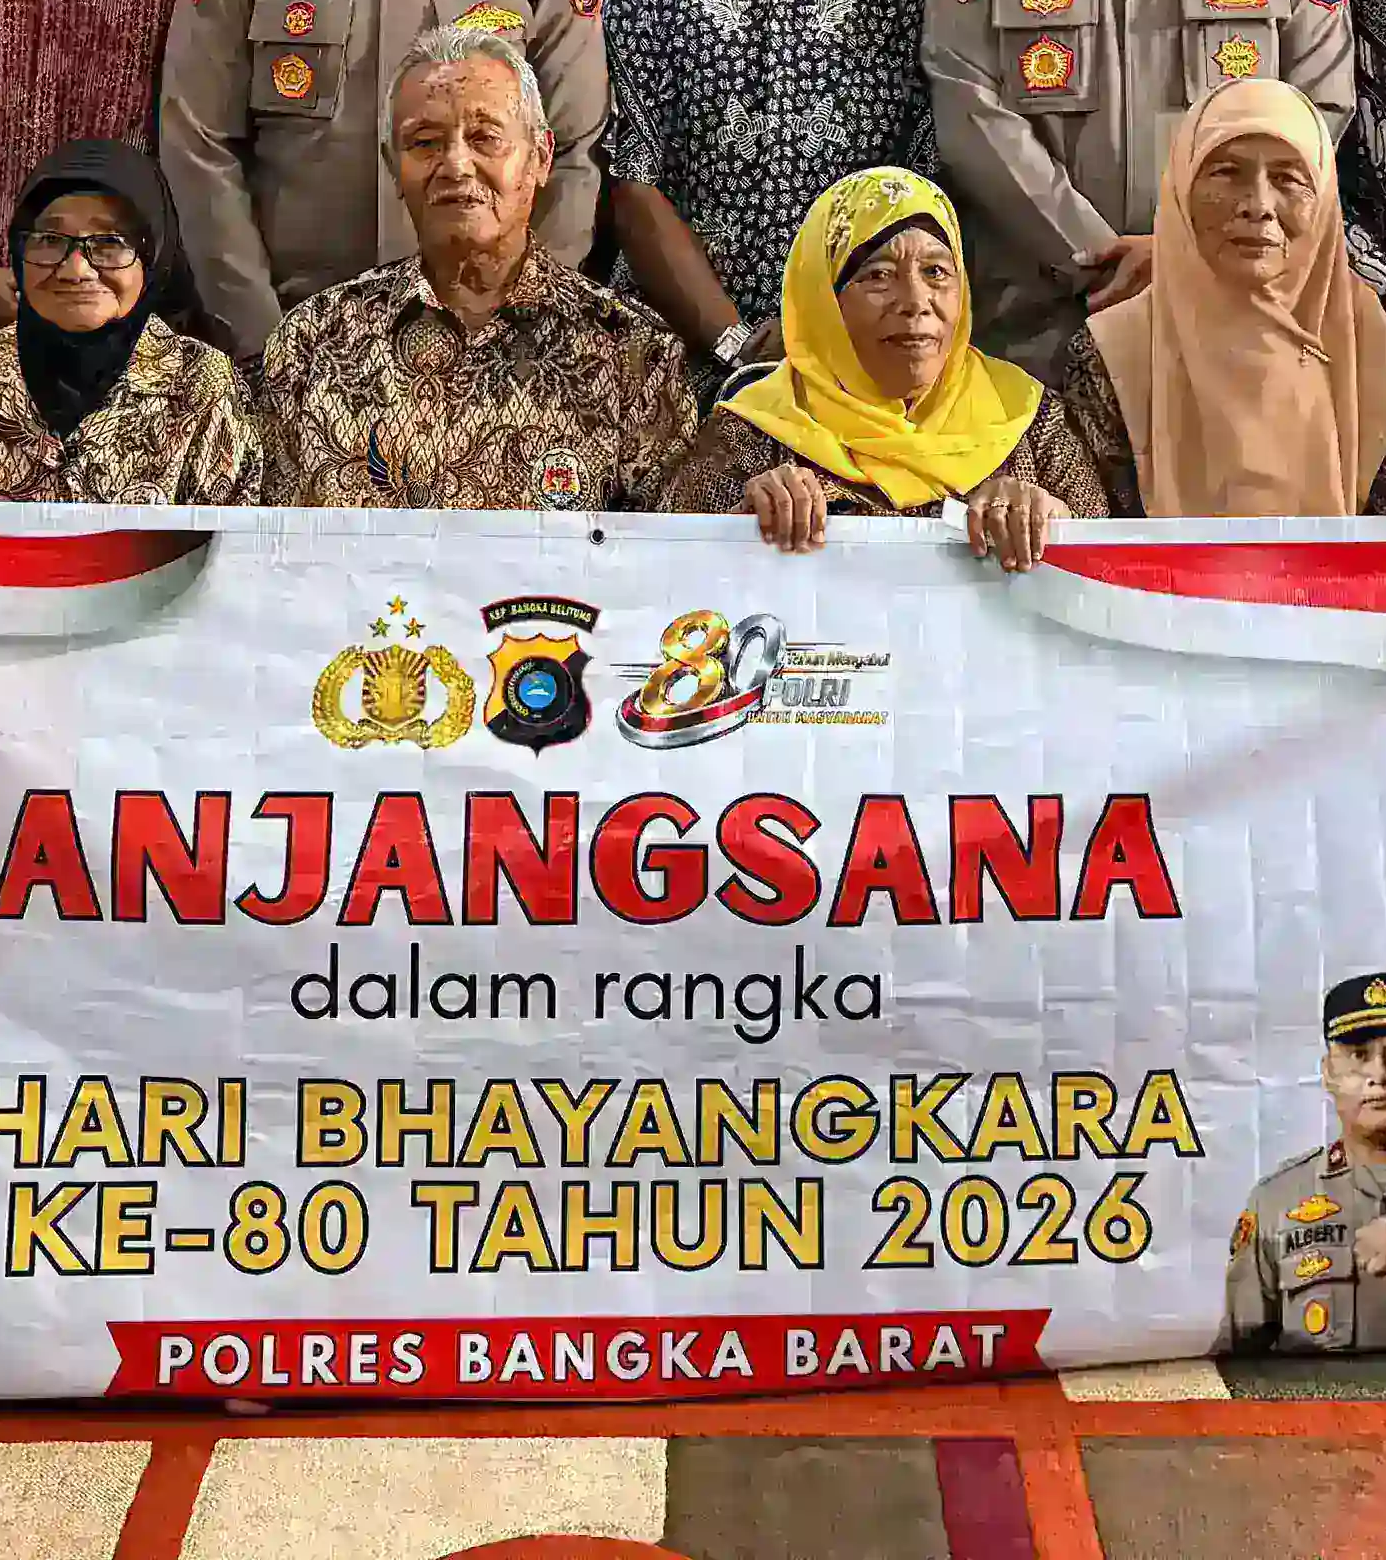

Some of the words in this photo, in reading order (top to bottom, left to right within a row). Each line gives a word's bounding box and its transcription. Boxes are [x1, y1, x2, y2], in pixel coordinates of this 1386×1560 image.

[763, 676, 853, 708] POLRI
[291, 943, 557, 1020] dalam
[594, 945, 883, 1044] rangka
[297, 1069, 1205, 1168] BHAYANGKARA
[5, 1180, 369, 1276] KE-80
[411, 1178, 824, 1273] TAHUN
[863, 1172, 1153, 1271] 2026
[1286, 1224, 1348, 1253] ALBERT
[157, 1330, 425, 1386] POLRES
[457, 1327, 747, 1383] BANGKA
[783, 1323, 1008, 1377] BARAT
